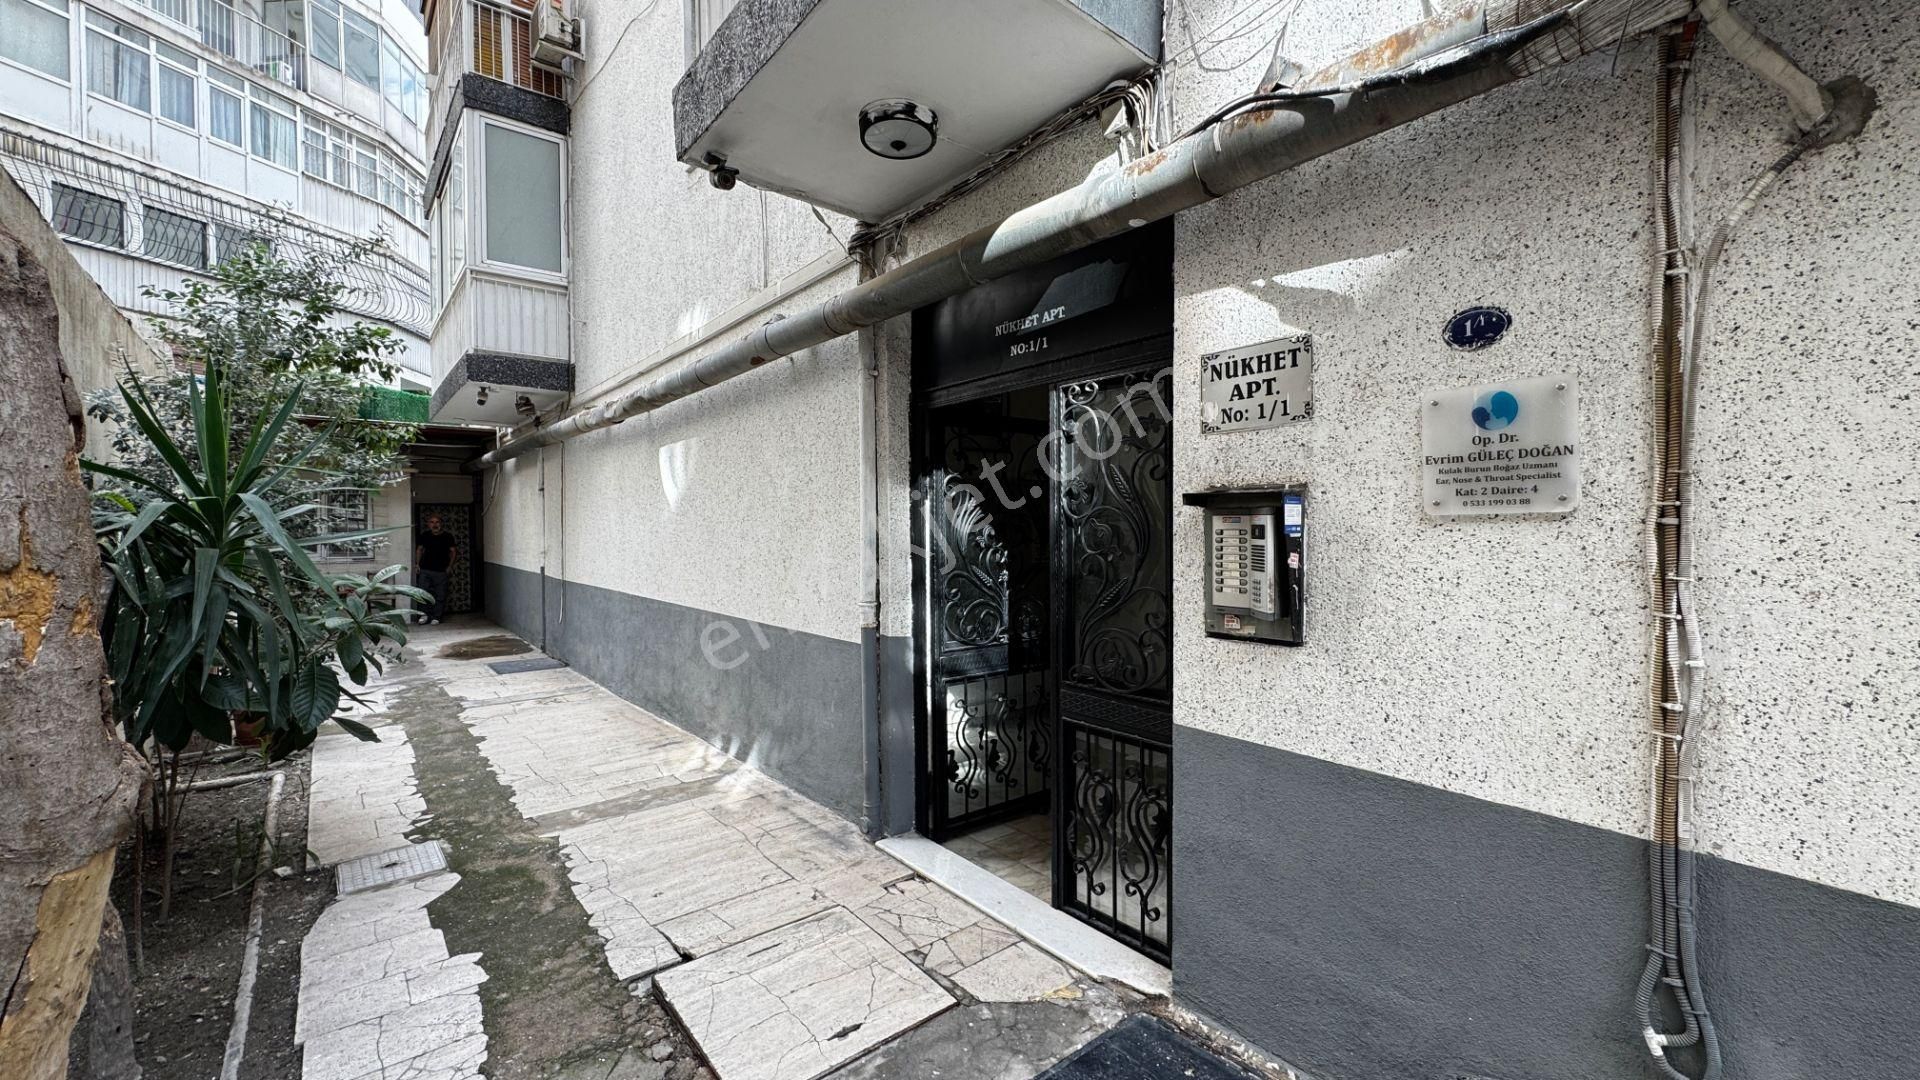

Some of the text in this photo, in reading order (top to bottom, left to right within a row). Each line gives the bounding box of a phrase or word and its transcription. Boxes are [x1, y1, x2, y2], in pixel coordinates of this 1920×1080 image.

[995, 313, 1039, 336] NÜKHET
[1010, 337, 1048, 356] NO:1/1
[1210, 347, 1301, 382] NÜKHET
[1229, 377, 1280, 401] APT.
[1221, 400, 1290, 424] No: 1/1
[1471, 433, 1519, 448] Op. Dr.
[1425, 444, 1574, 465] Evrim GÜLEÇ DOĞAN
[1438, 462, 1558, 475] Kulak Burun Boğaz Uzmanı
[1484, 474, 1514, 482] Throat
[1516, 471, 1562, 481] Specialist
[1455, 484, 1538, 497] Kat: 2 Daire: 4
